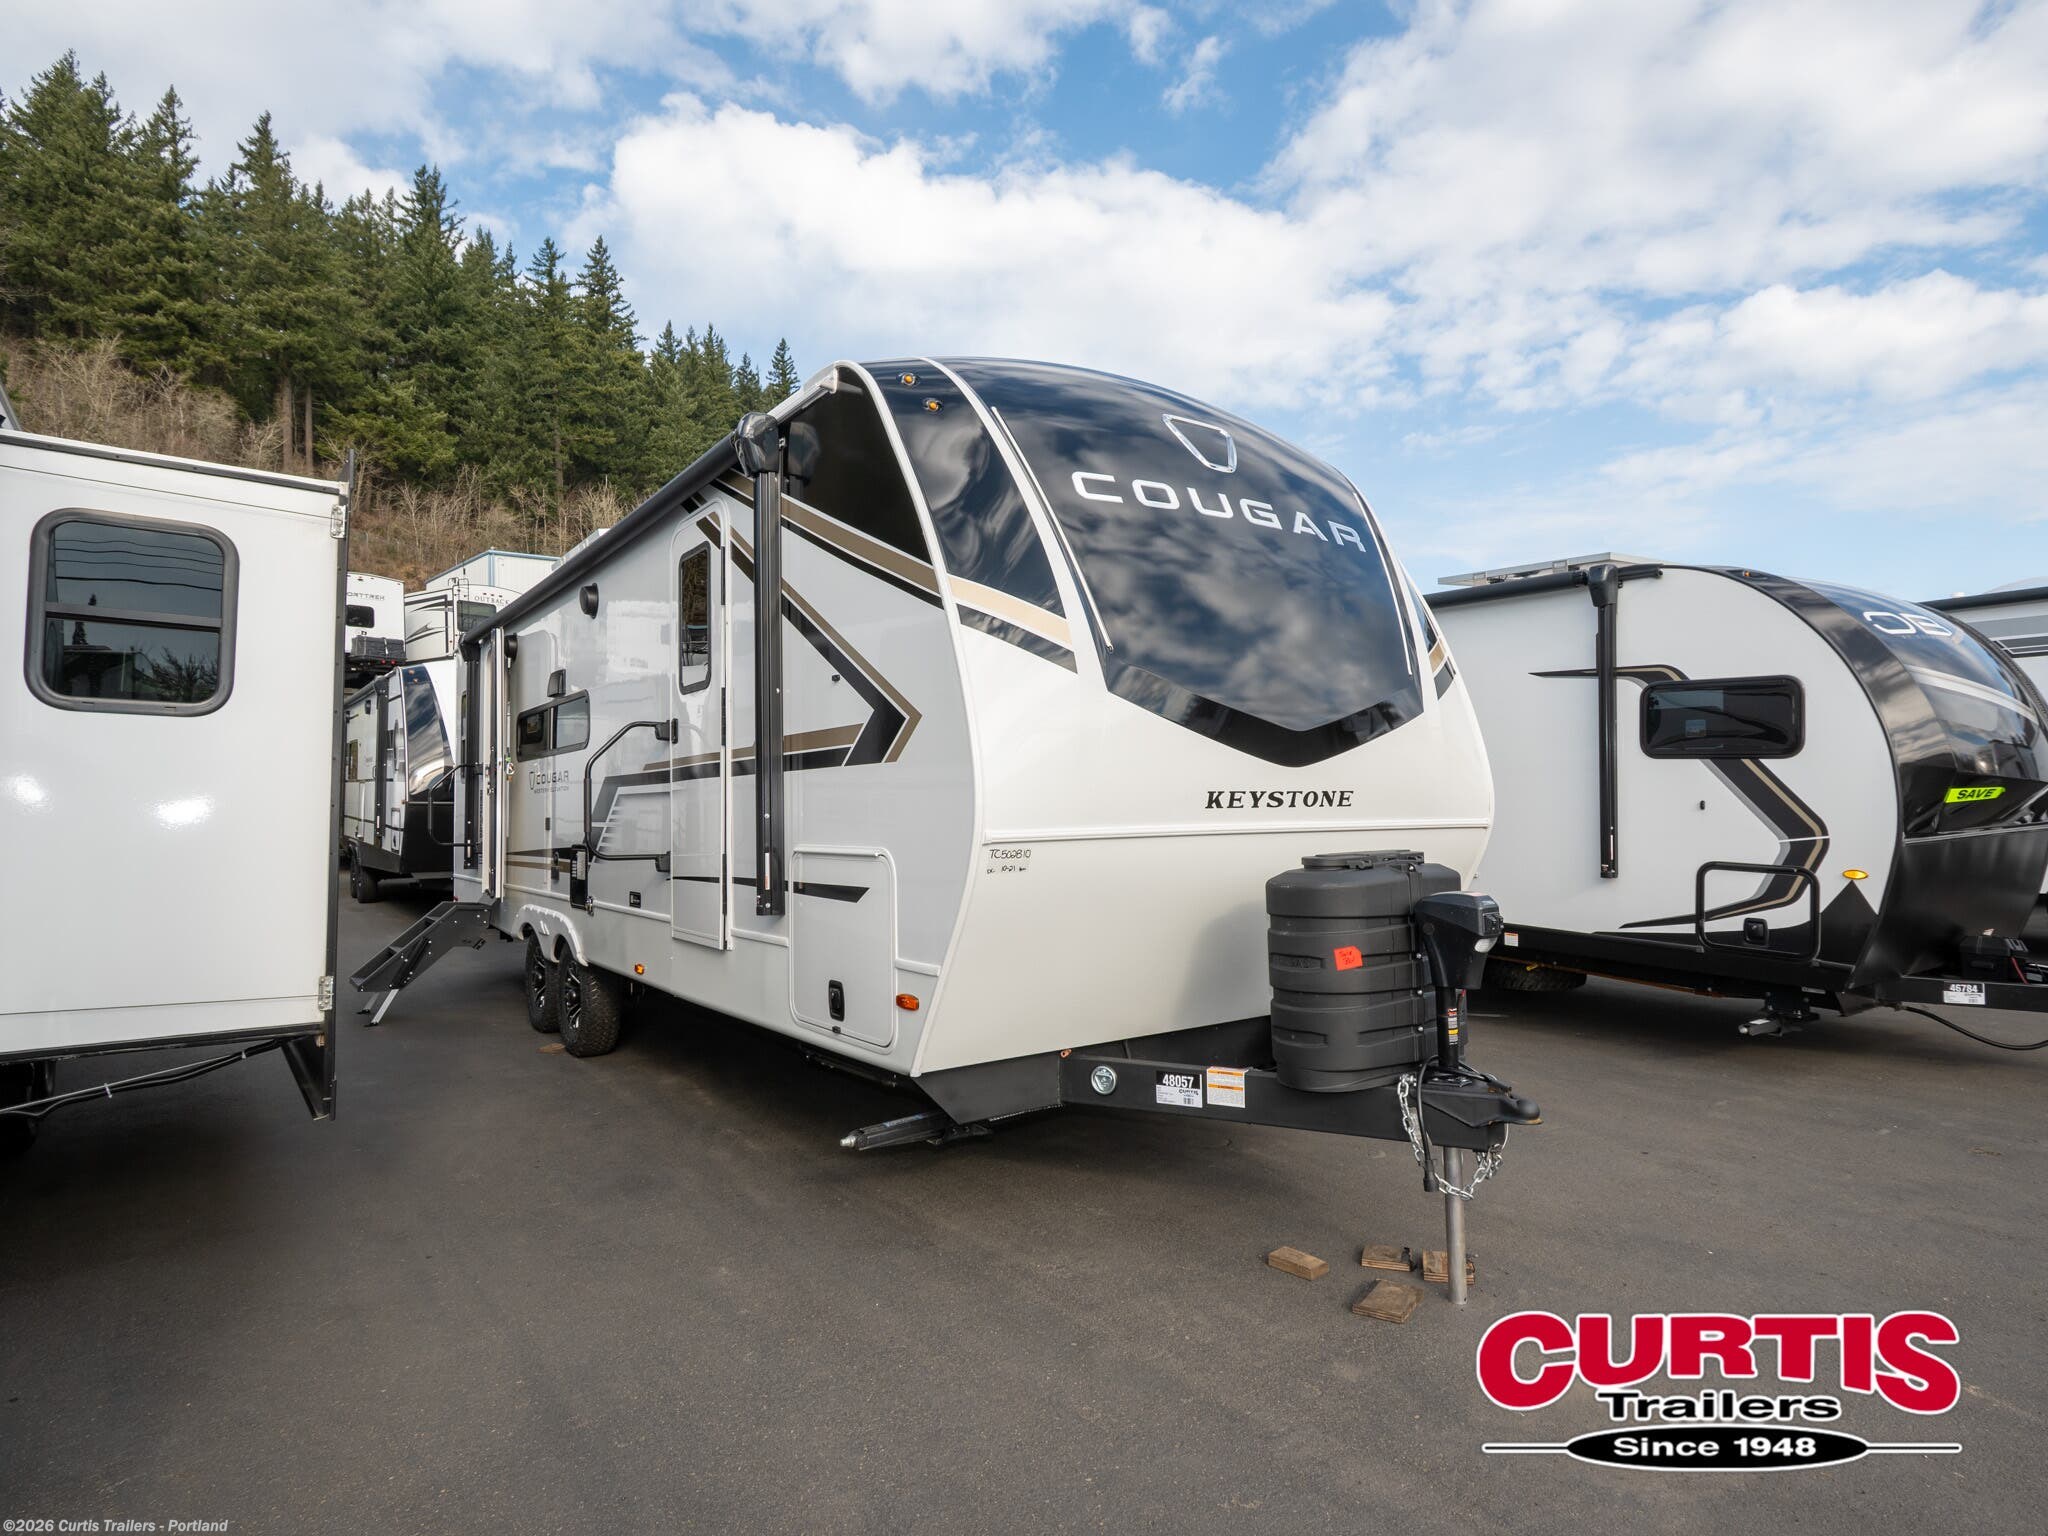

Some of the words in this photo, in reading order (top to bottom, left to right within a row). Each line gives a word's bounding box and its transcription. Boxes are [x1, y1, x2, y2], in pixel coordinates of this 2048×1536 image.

[1071, 471, 1367, 553] COUGAR
[474, 595, 510, 606] OUTBACK
[536, 770, 569, 785] COUGAR
[1204, 790, 1354, 809] KEYSTONE
[1956, 788, 1997, 800] SAVE
[1162, 1073, 1194, 1089] 48057
